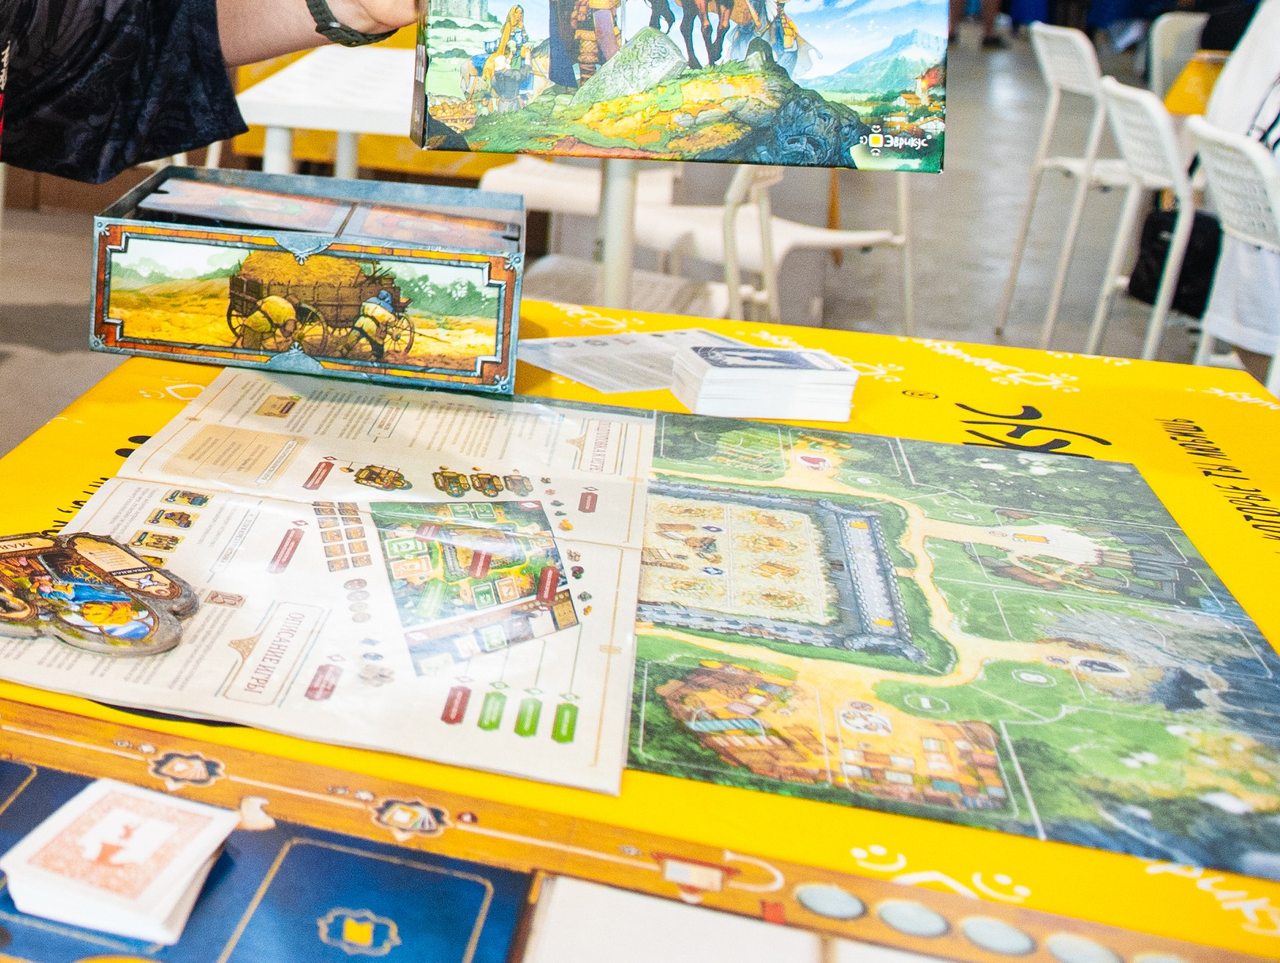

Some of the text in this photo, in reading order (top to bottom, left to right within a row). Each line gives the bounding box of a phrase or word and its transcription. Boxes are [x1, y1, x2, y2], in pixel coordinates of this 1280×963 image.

[883, 134, 929, 150] Эврикус
[261, 611, 305, 665] ОПИСАНИЕ
[243, 662, 276, 694] ИГРЫ
